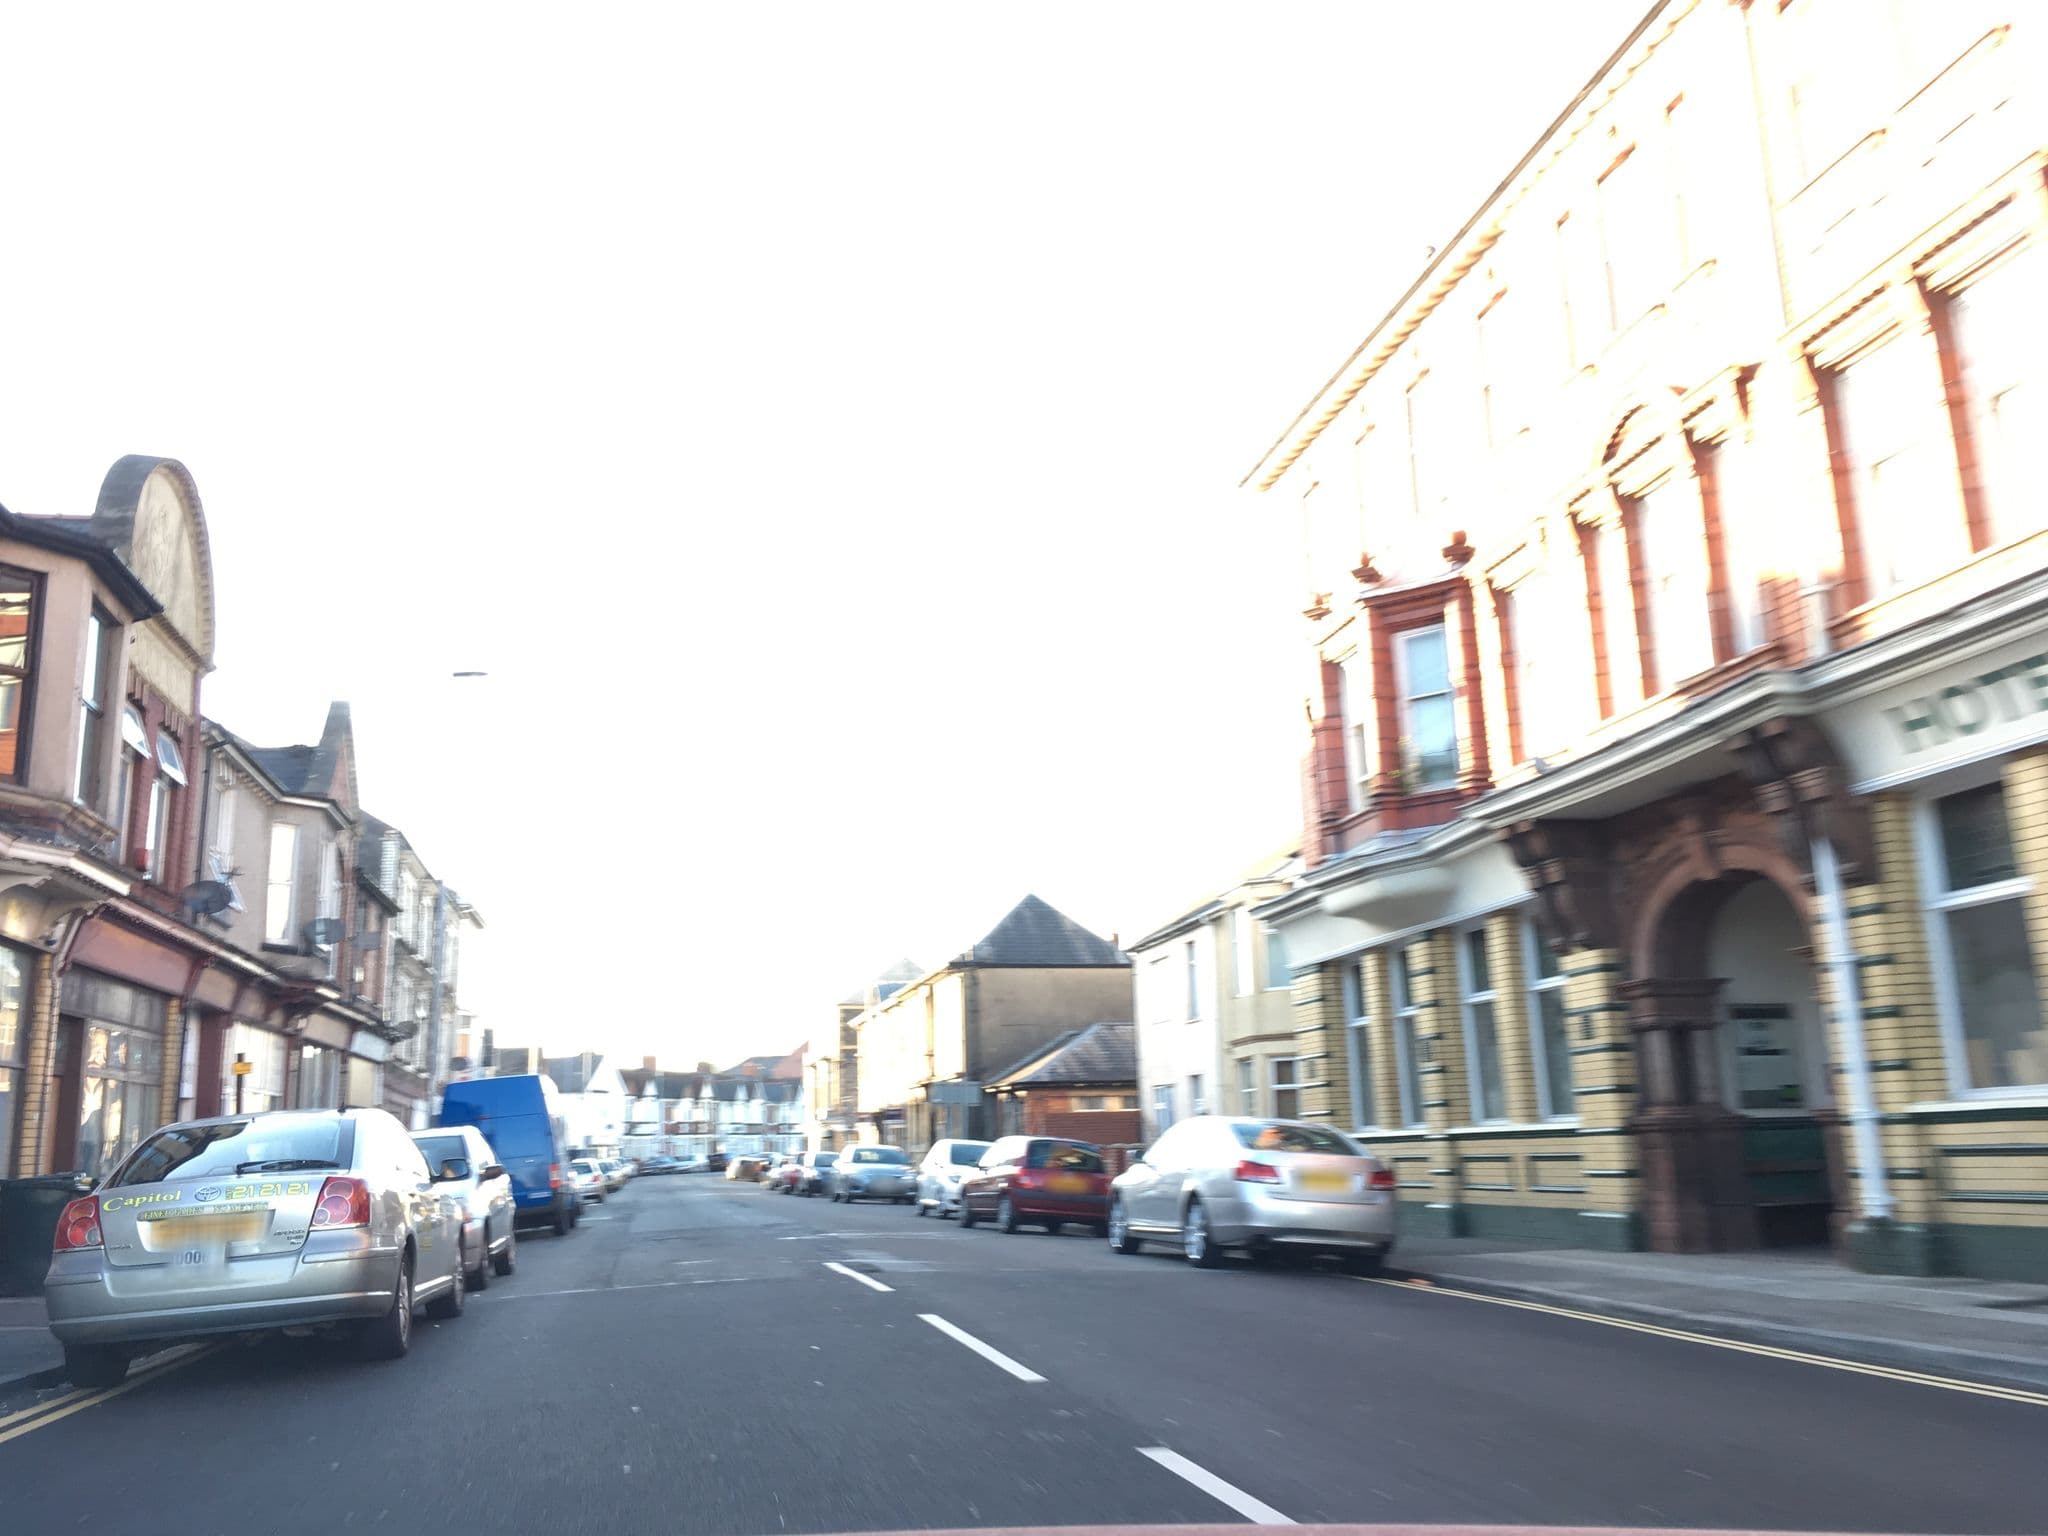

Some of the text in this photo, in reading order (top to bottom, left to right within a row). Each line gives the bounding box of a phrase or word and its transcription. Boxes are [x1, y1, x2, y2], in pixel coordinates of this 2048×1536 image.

[233, 1185, 254, 1199] 21
[260, 1183, 281, 1197] 21
[287, 1182, 309, 1196] 21
[103, 1190, 181, 1211] Capitol
